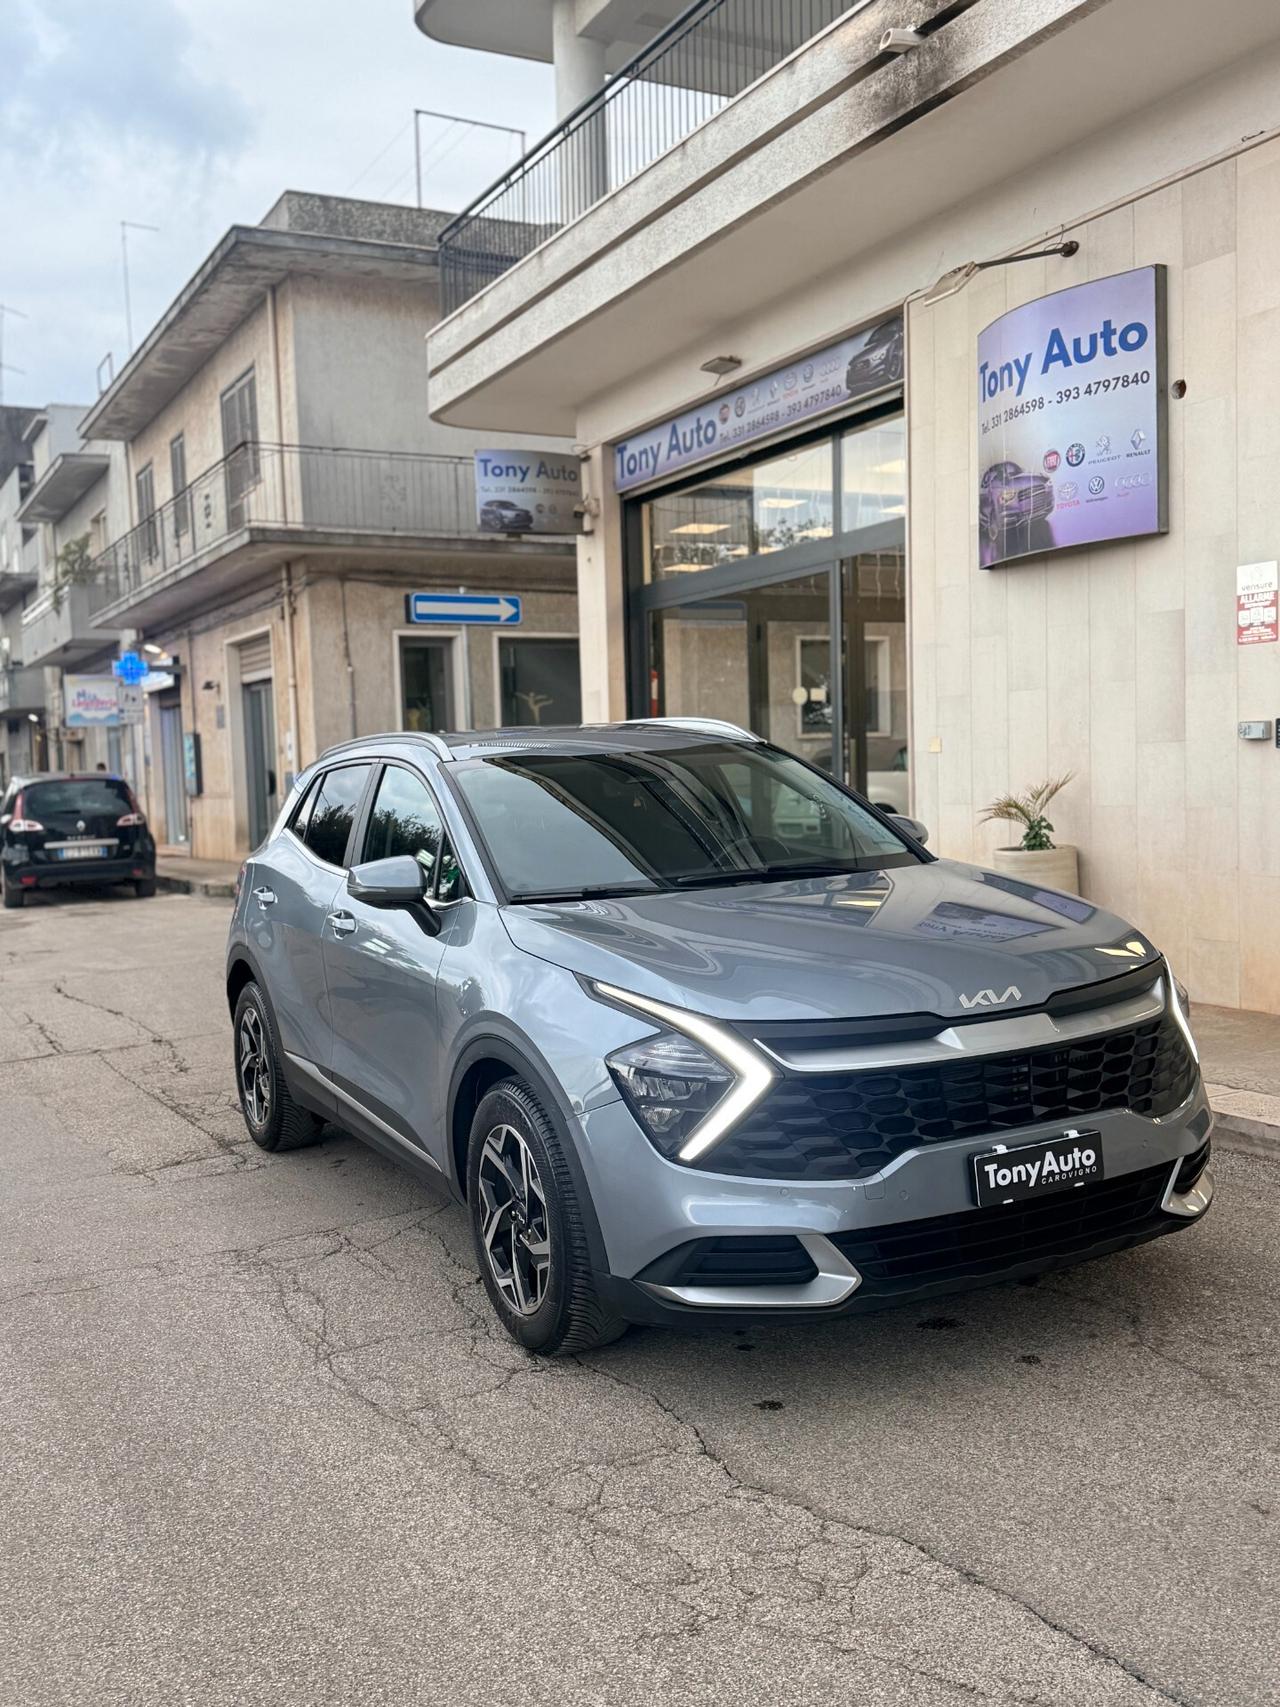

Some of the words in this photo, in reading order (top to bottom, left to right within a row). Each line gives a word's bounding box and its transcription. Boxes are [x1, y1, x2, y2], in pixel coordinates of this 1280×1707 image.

[980, 353, 1032, 402] Tony
[1041, 320, 1148, 375] Auto
[732, 426, 745, 438] 331
[747, 411, 780, 433] 2864598
[787, 401, 802, 416] 393
[803, 385, 842, 408] 4797840
[981, 423, 990, 434] Tel.
[992, 414, 1002, 429] 331
[1004, 397, 1045, 423] 2864598
[1056, 387, 1080, 404] 393
[1084, 370, 1150, 396] 4797840
[617, 442, 661, 479] Tony
[666, 418, 717, 460] Auto
[1126, 449, 1151, 458] RENAULT
[479, 458, 530, 483] Tony
[536, 461, 578, 482] Auto
[1057, 499, 1080, 510] TOYOTA
[984, 1147, 1096, 1188] TonyAuto
[1041, 1166, 1097, 1185] CAROVIGNO
